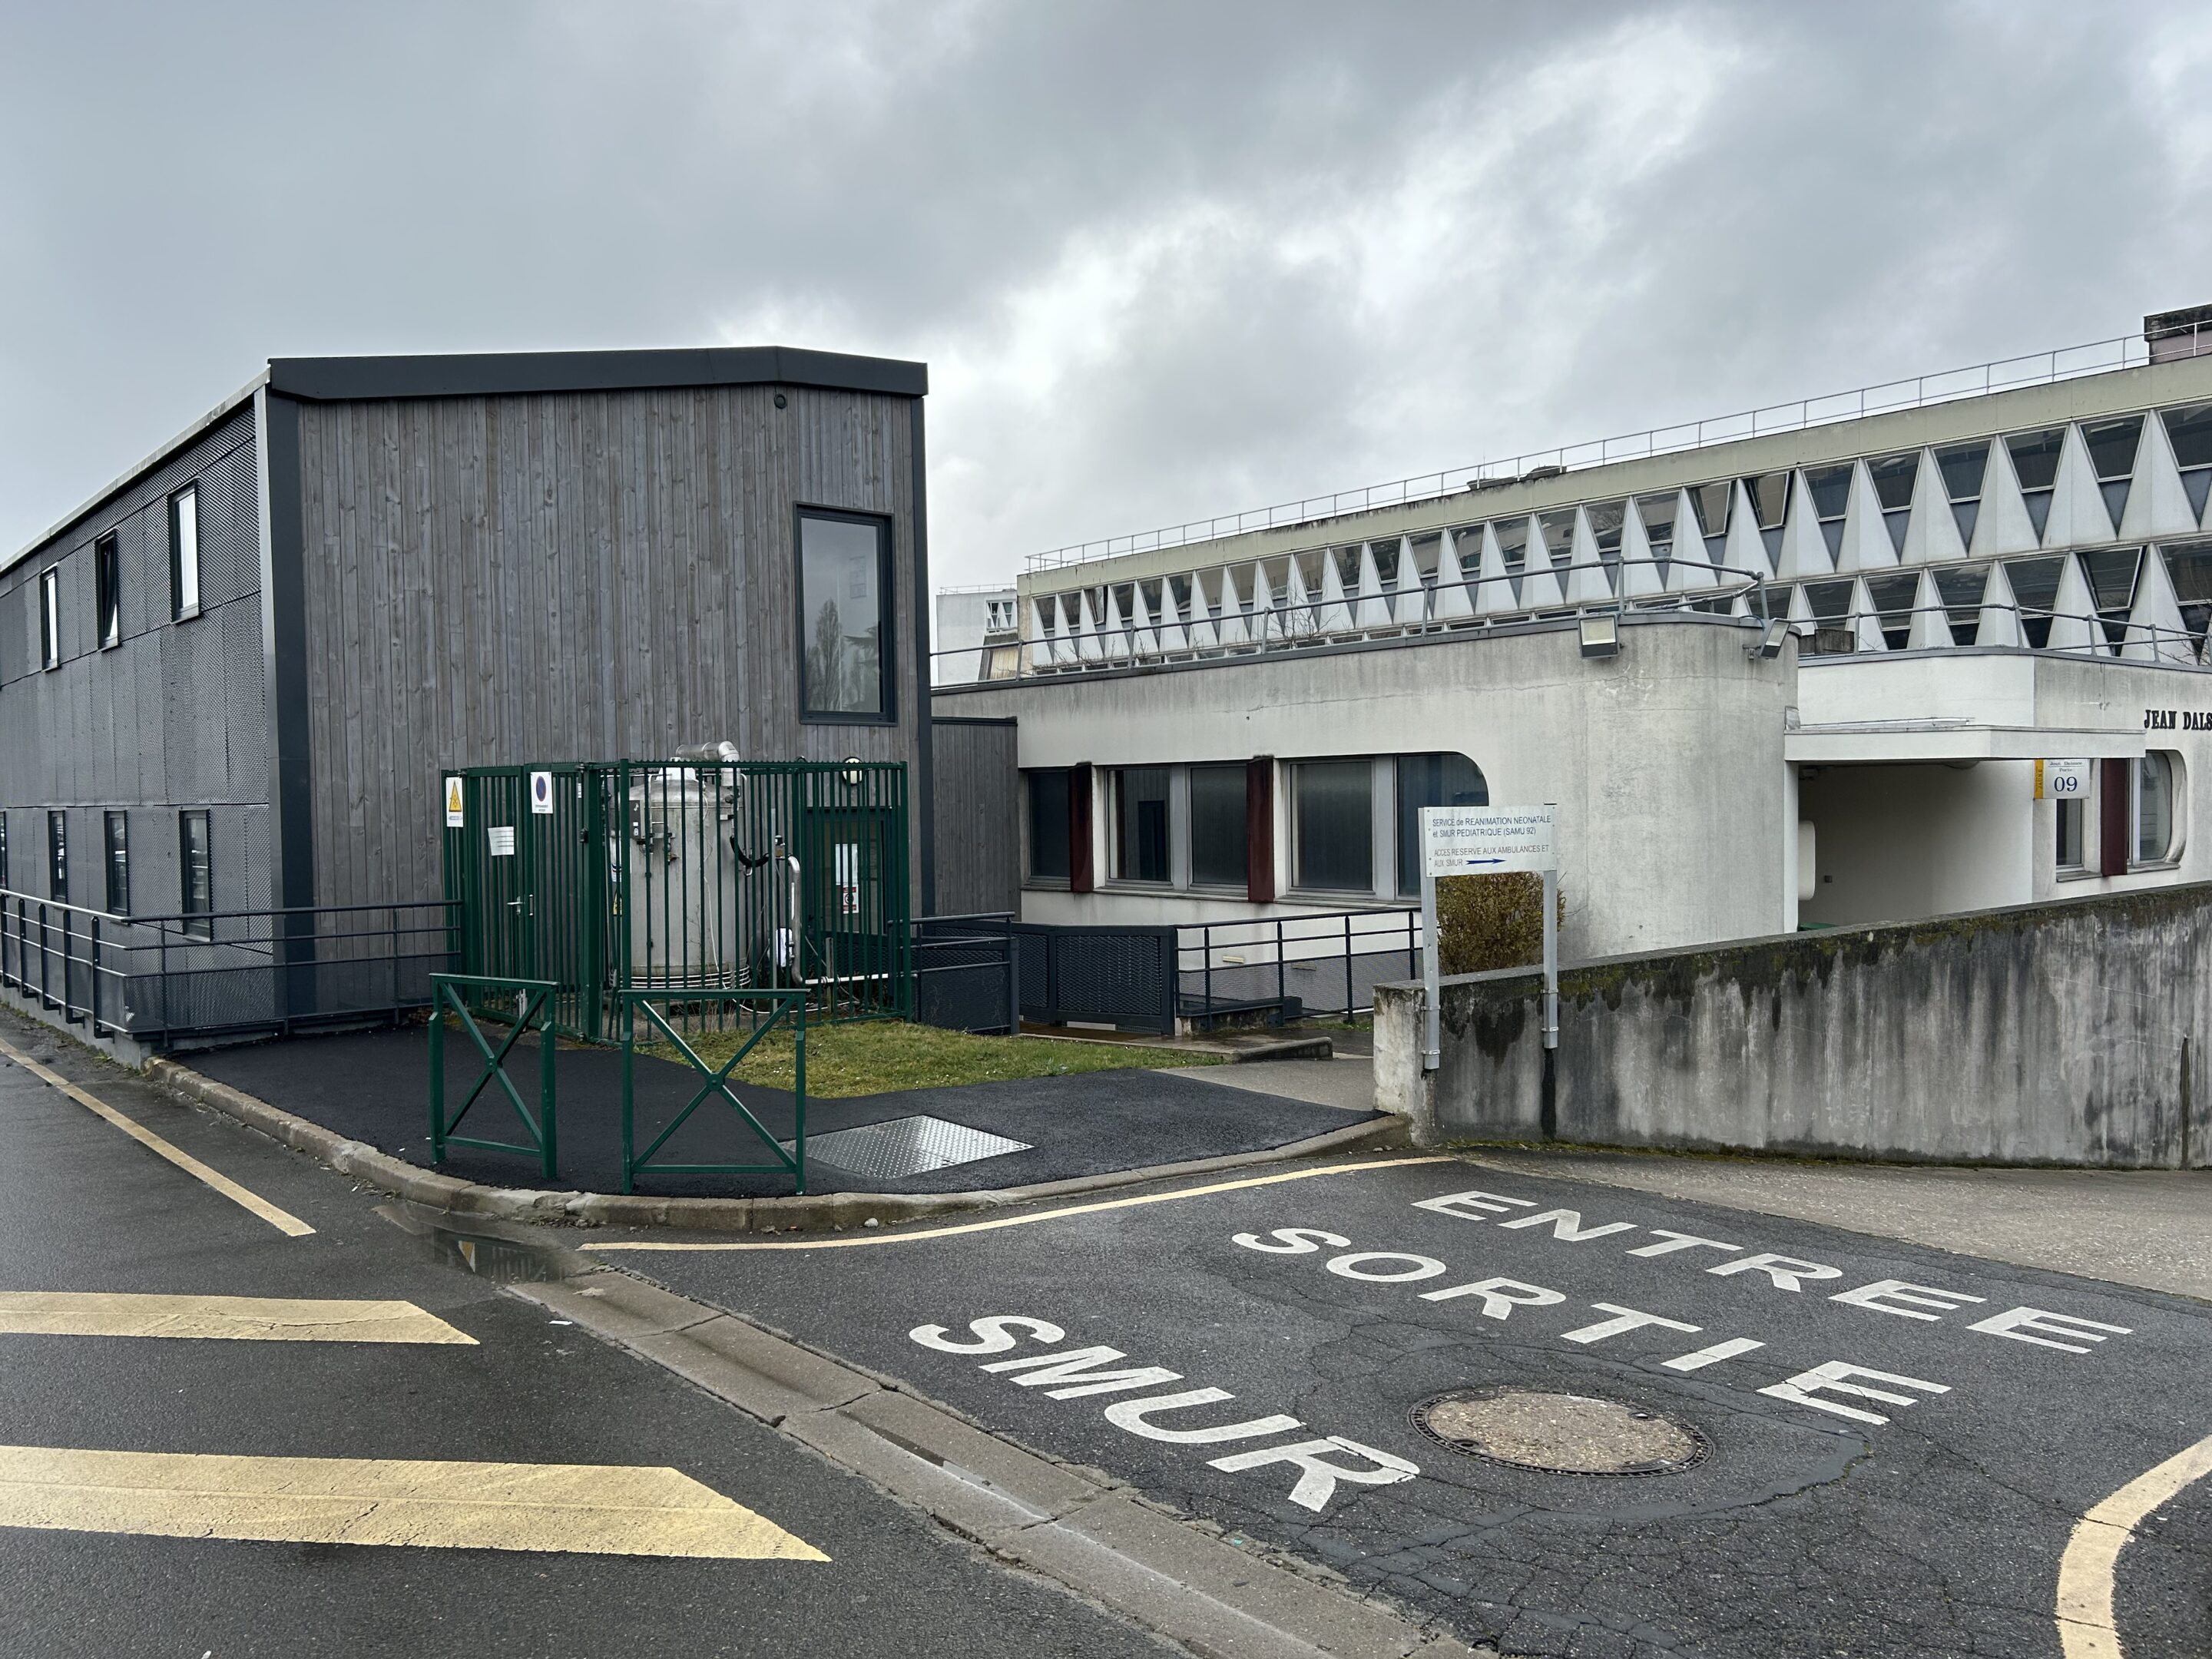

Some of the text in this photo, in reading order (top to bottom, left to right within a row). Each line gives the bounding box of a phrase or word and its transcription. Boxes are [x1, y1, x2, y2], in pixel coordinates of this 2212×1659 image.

[2144, 710, 2177, 729] JEAN
[2055, 777, 2078, 792] 09
[1432, 818, 1455, 826] SERVICE
[1465, 817, 1512, 826] REANIMATION
[1514, 815, 1551, 824] NEONATALE
[1439, 829, 1455, 837] SMUR
[1457, 828, 1502, 837] PEDIATRIQUE
[1503, 827, 1525, 837] (SAMU
[1526, 826, 1536, 836] 92)
[1434, 848, 1450, 856] ACCES
[1452, 847, 1482, 856] RESERVE
[1482, 846, 1496, 855] AUX
[1498, 845, 1540, 854] AMBULANCES
[1446, 858, 1463, 866] SMUR
[1410, 1190, 2134, 1355] ENTREE
[1231, 1227, 1952, 1426] SORTIE
[909, 1315, 1421, 1513] SMUR
